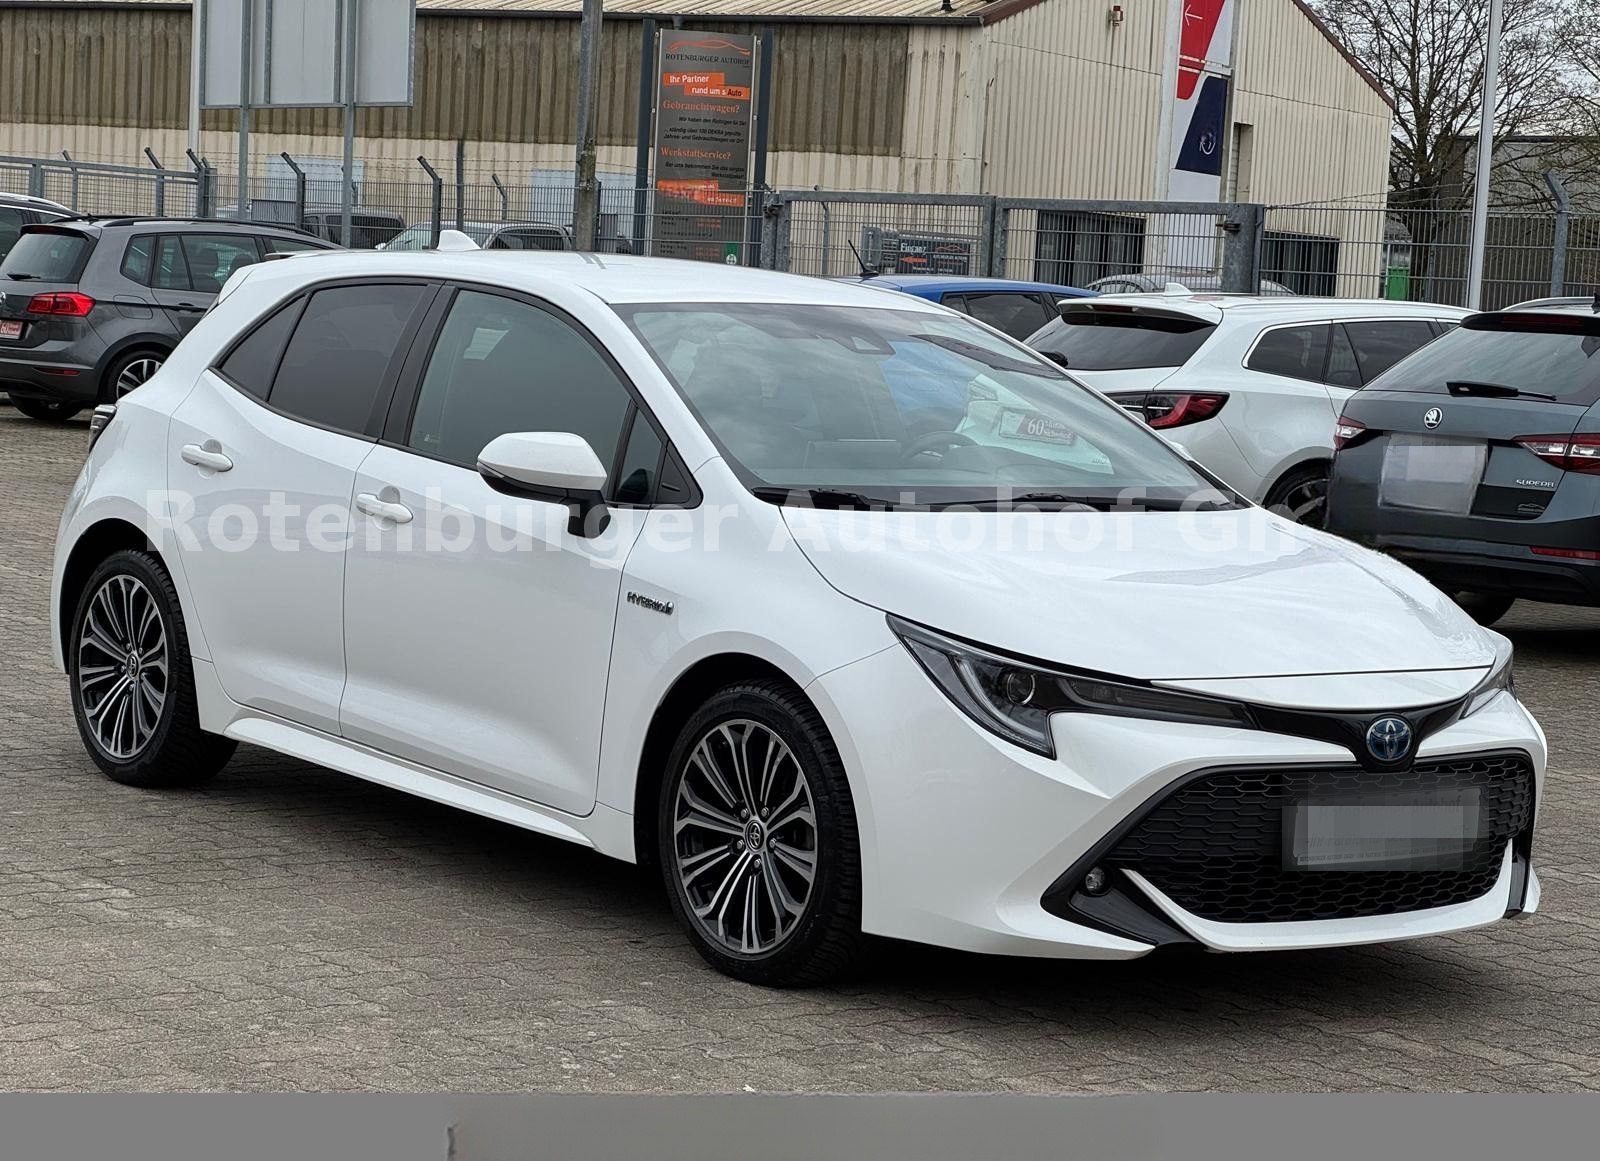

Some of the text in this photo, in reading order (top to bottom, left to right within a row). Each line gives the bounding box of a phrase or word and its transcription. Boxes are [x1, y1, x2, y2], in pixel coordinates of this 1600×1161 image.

[665, 53, 719, 62] ROTENBURGER
[681, 74, 709, 82] Partner
[663, 100, 740, 113] Gebrauchtwagen?
[661, 147, 731, 160] Werkstattservice?
[1027, 419, 1044, 435] 60
